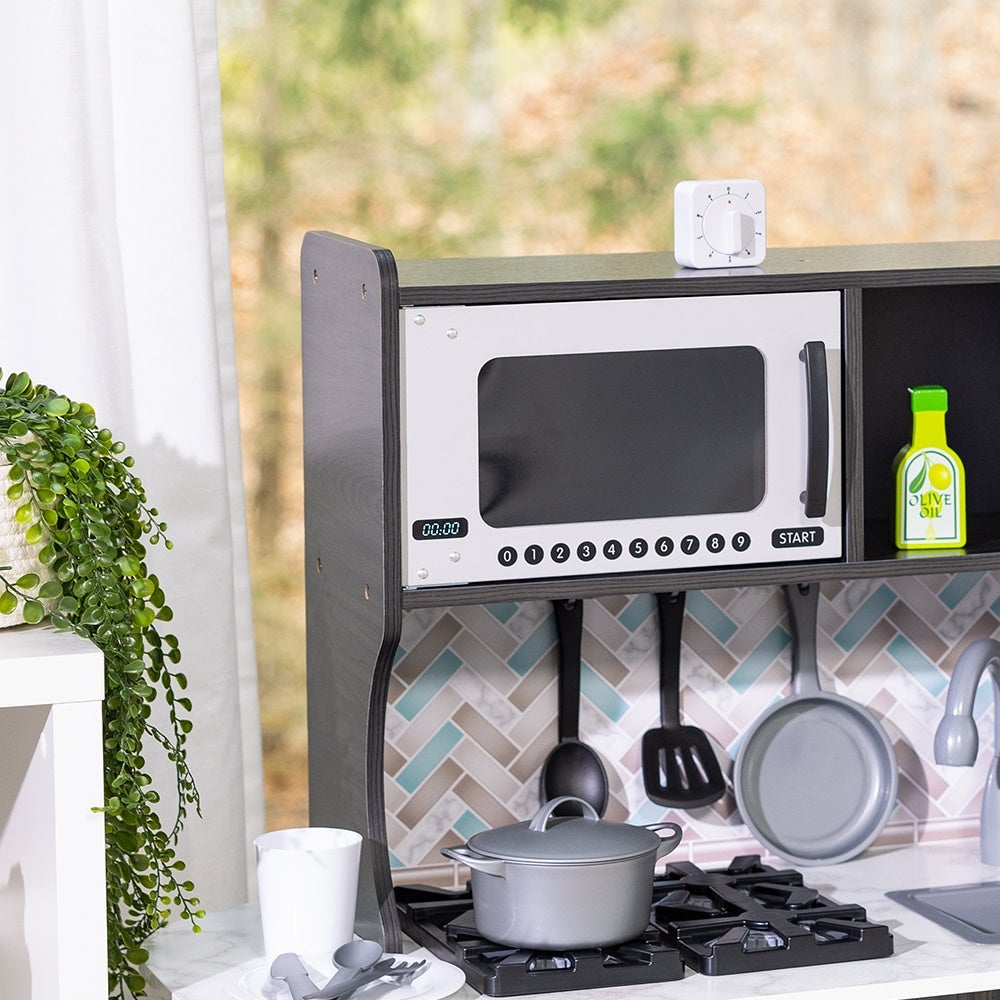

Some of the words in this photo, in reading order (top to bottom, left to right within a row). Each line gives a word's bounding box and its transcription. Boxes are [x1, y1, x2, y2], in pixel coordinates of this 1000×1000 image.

[908, 493, 952, 507] OLIVE
[919, 506, 943, 519] OIL
[421, 521, 460, 537] 00:00
[779, 530, 816, 545] START
[503, 550, 512, 562] 0
[531, 548, 536, 560] 1
[556, 547, 564, 559] 2
[582, 545, 590, 557] 3
[607, 543, 615, 555] 4
[635, 542, 642, 554] 5
[660, 540, 668, 552] 6
[686, 538, 694, 551] 7
[711, 537, 719, 549] 8
[737, 535, 745, 547] 9
